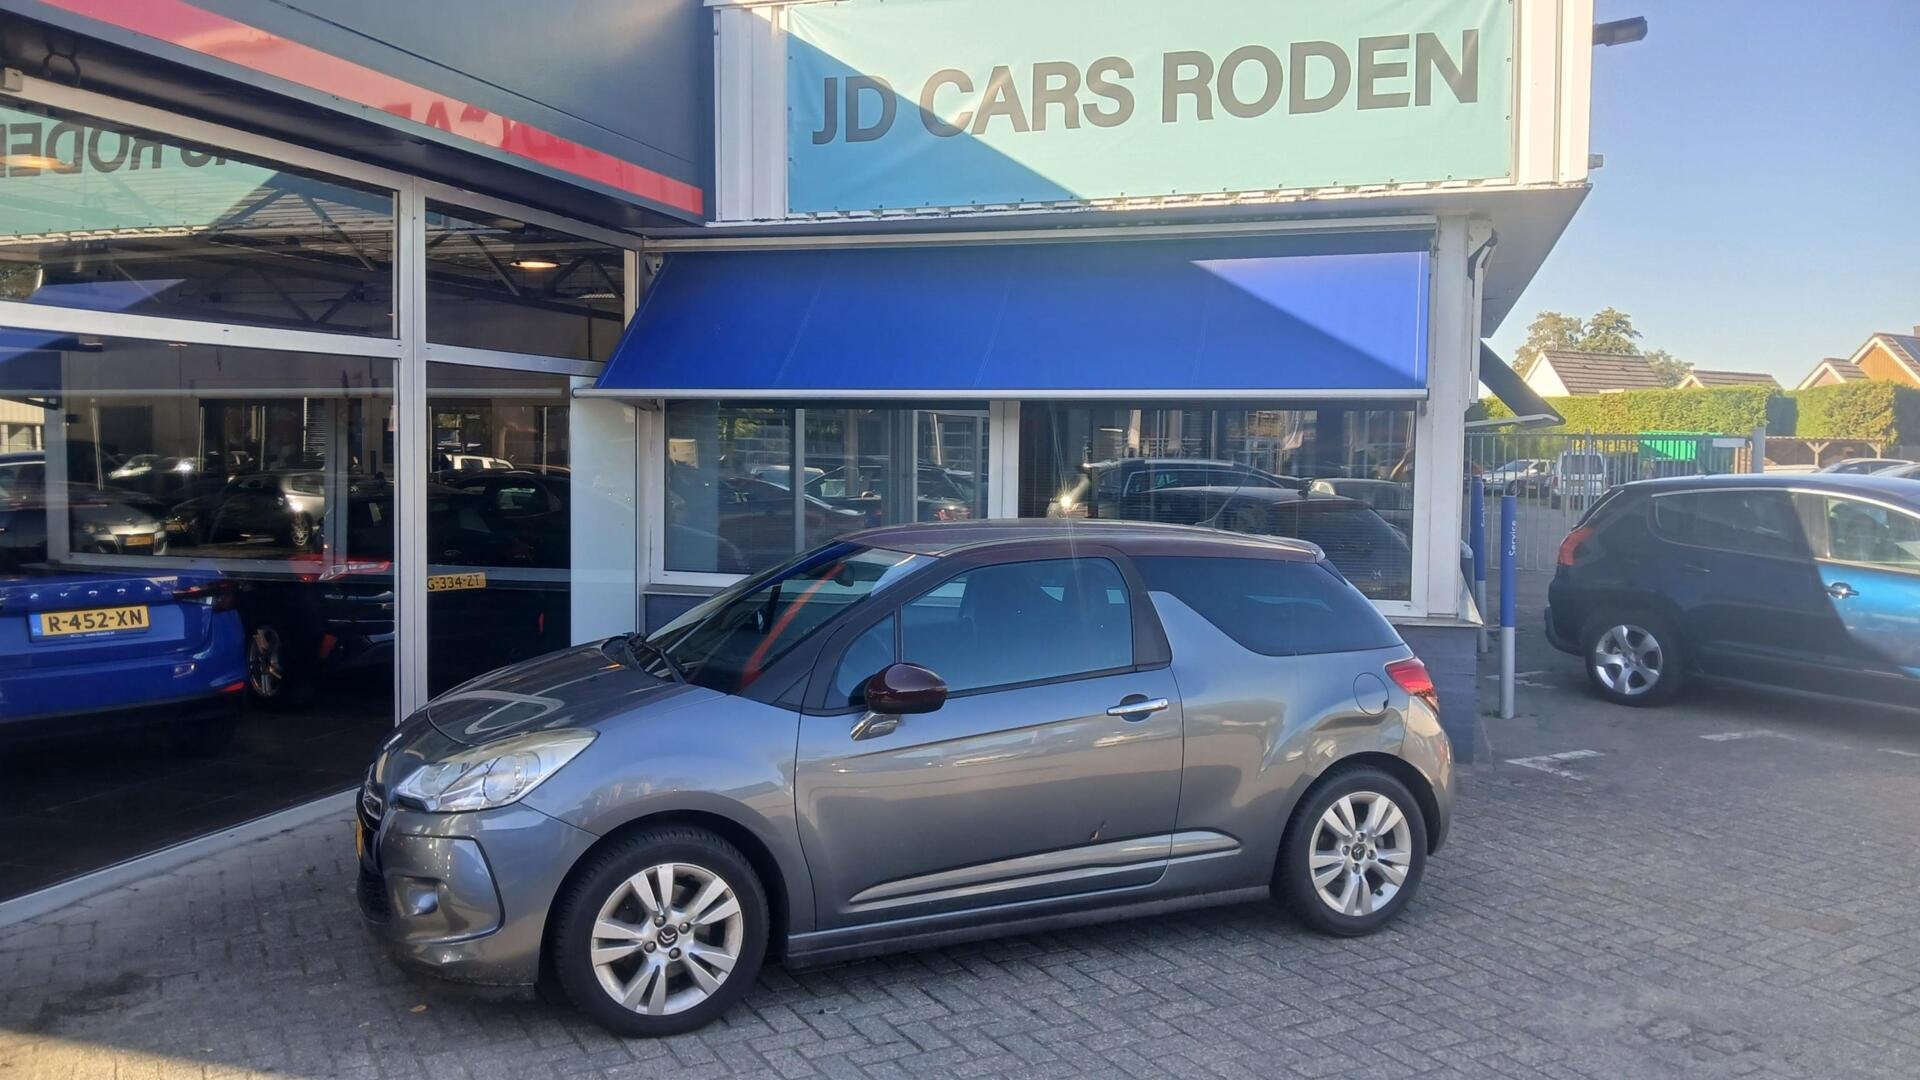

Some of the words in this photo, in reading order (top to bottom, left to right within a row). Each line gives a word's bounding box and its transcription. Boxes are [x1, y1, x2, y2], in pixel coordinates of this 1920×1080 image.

[812, 75, 897, 145] JD
[919, 56, 1135, 138] CARS
[1161, 29, 1479, 123] RODEN
[427, 574, 480, 590] G-334-ZT
[48, 609, 143, 632] R-452-XN
